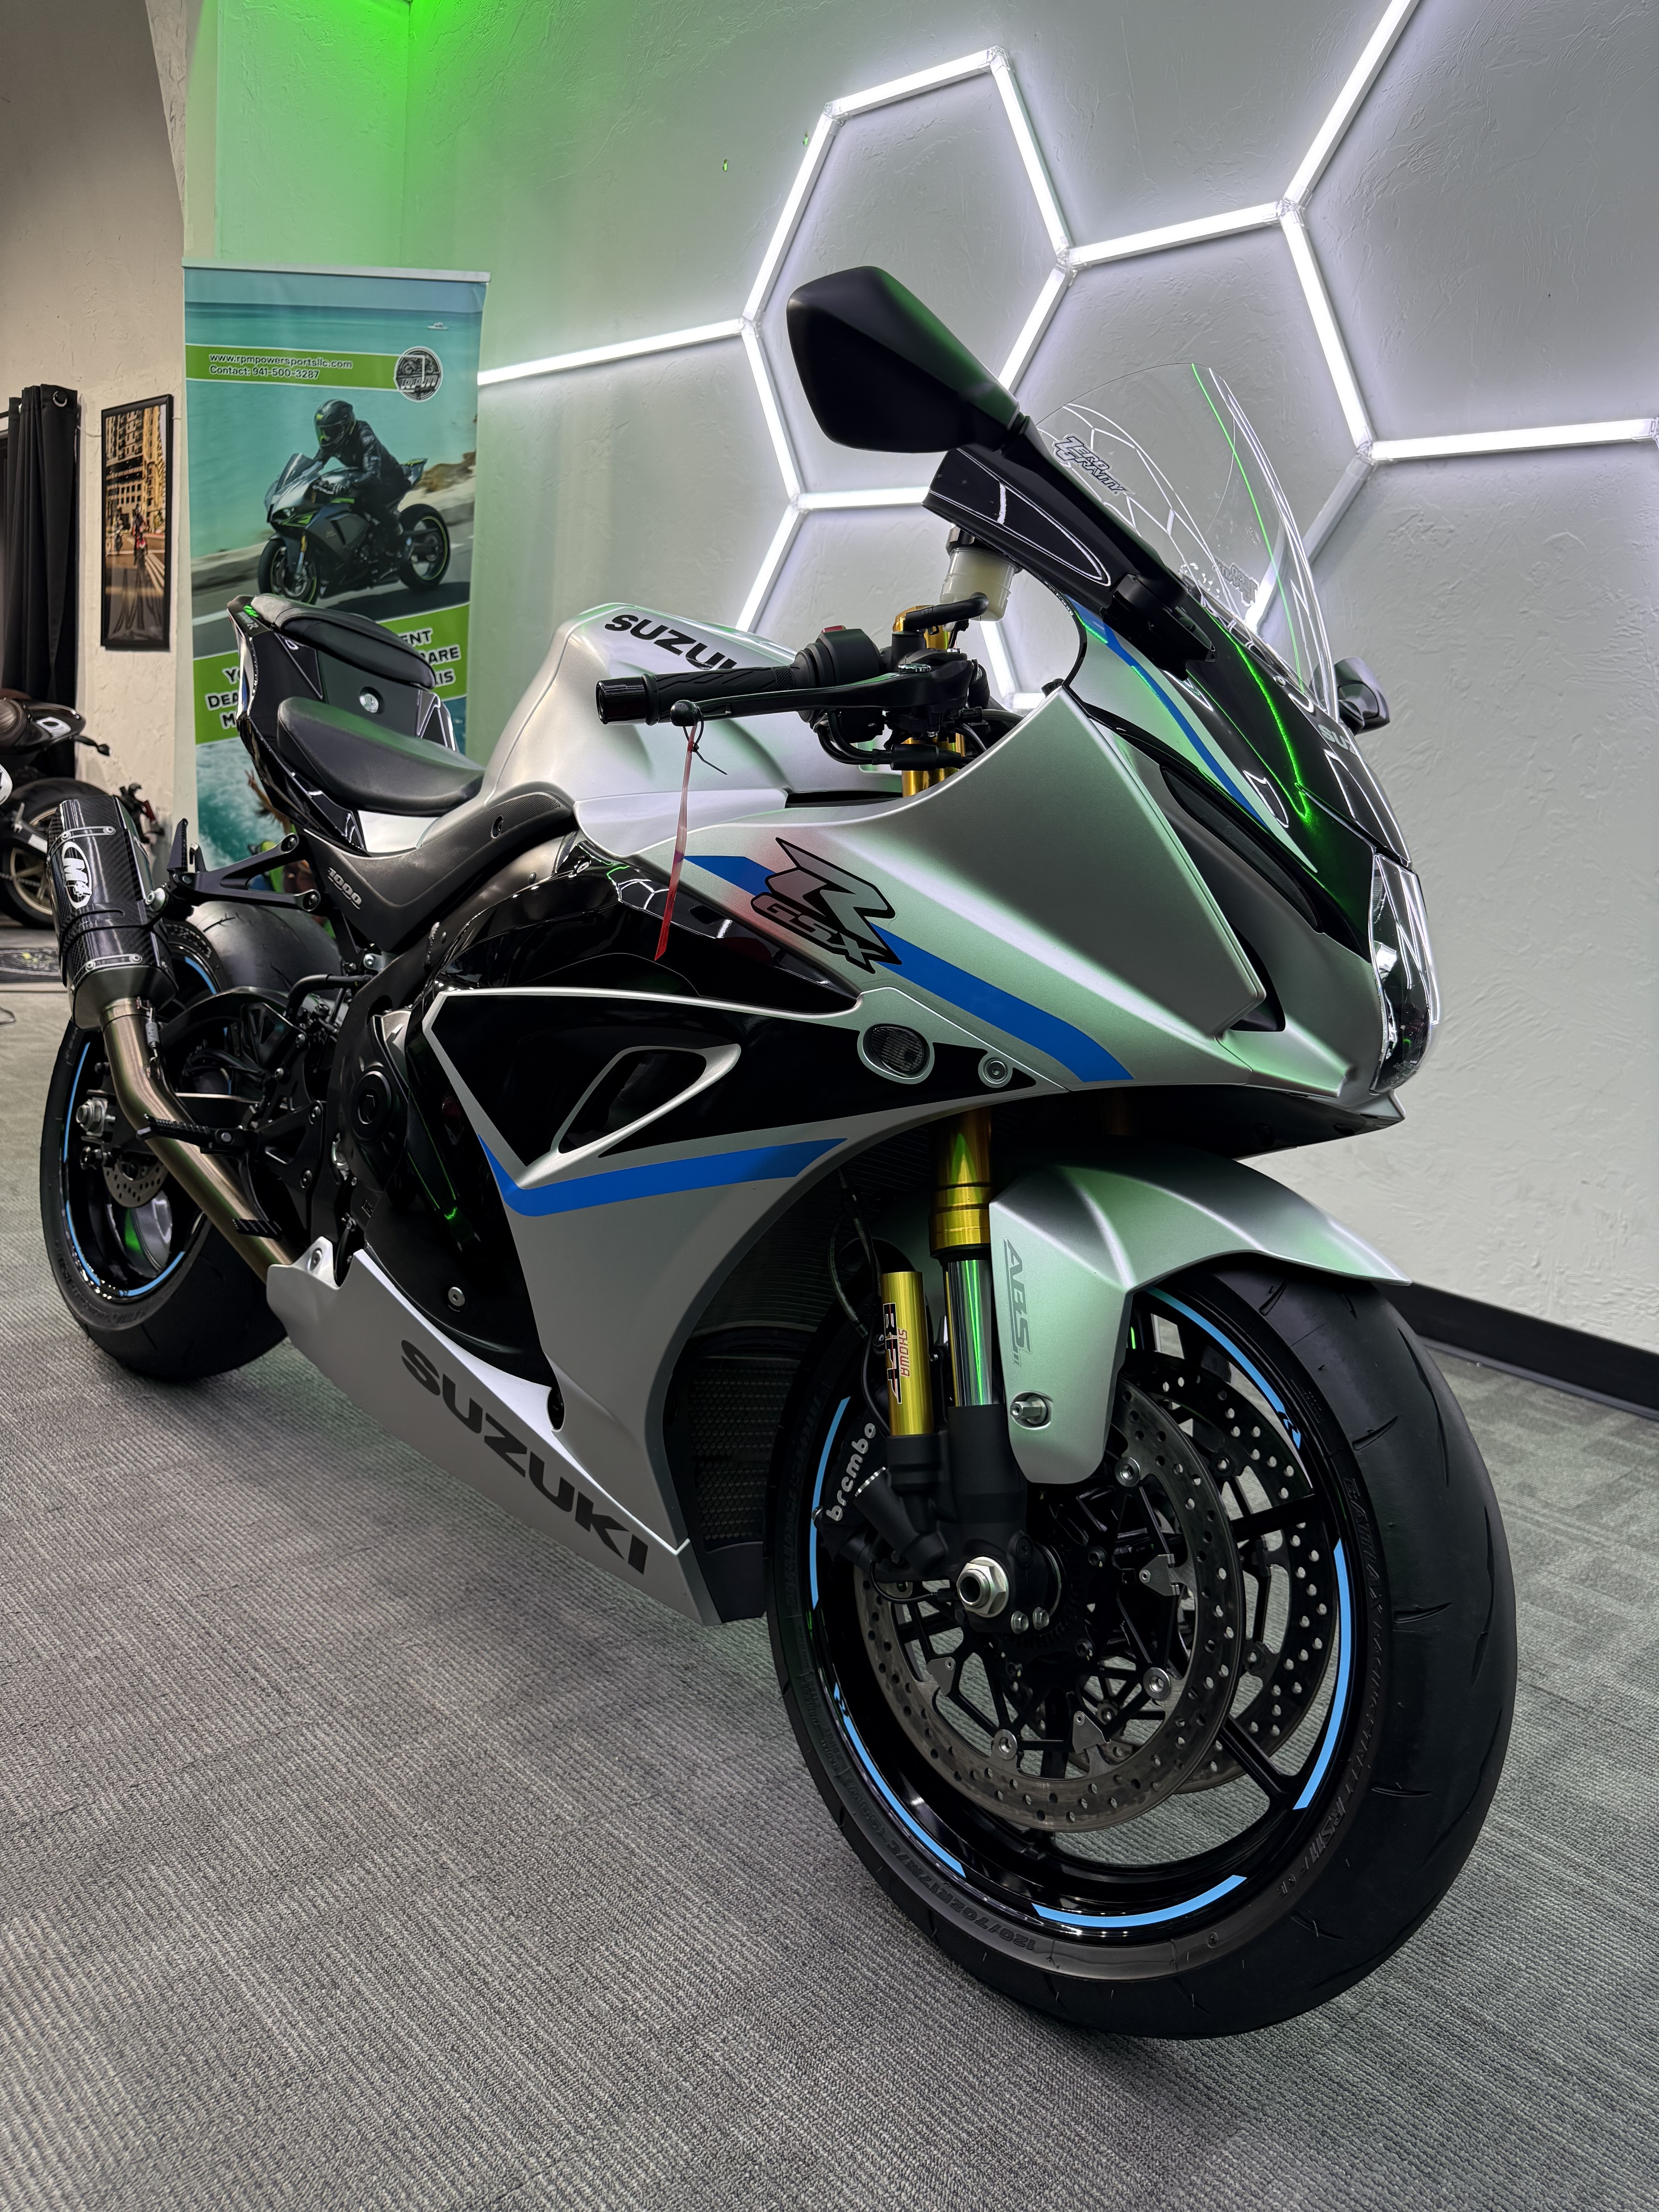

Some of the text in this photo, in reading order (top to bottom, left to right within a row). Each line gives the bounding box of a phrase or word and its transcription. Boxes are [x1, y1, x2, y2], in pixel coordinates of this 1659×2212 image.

[210, 354, 352, 369] www.rpmpowersportsllc.com
[210, 365, 320, 380] Contact: 941-500-3287
[1054, 436, 1110, 471] ZERO
[1056, 449, 1128, 492] GRAVITY
[604, 614, 738, 670] SUZU
[225, 668, 240, 683] Y
[327, 867, 362, 909] 1000
[1003, 1238, 1031, 1359] ABS
[897, 1327, 910, 1378] SHOWA
[401, 1339, 648, 1575] SUZUKI
[826, 1423, 876, 1522] brembo
